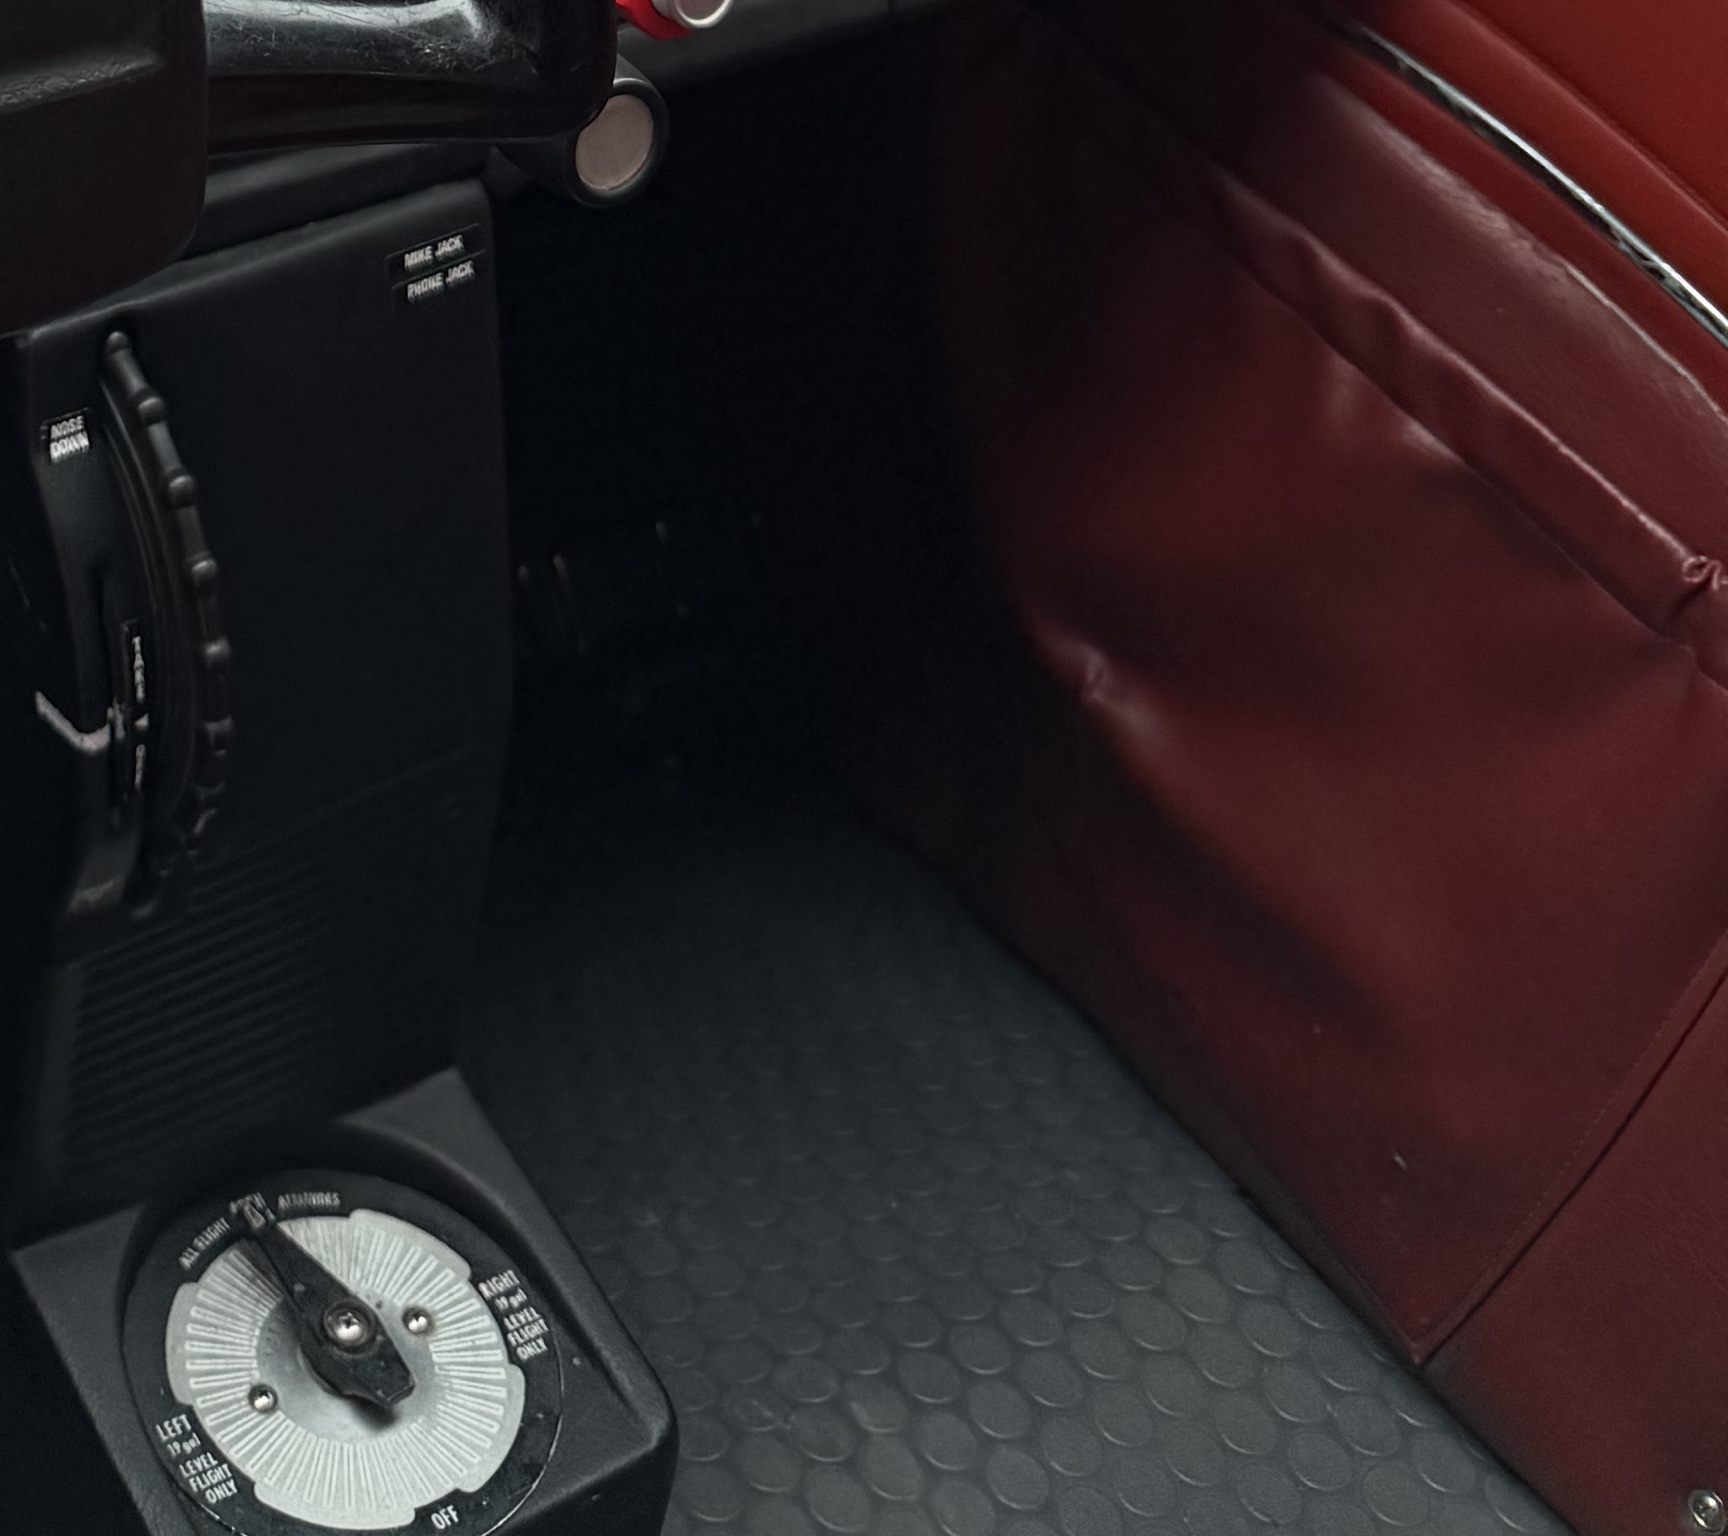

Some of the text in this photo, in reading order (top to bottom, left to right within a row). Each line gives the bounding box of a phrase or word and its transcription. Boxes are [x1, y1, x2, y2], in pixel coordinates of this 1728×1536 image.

[478, 1270, 520, 1300] RIGHT
[503, 1307, 541, 1330] LEVEL
[507, 1319, 549, 1346] FLIGHT
[516, 1337, 548, 1361] ONLY
[156, 1414, 192, 1442] LEFT
[179, 1452, 218, 1478] LEVEL
[189, 1464, 232, 1493] FLIGHT
[205, 1479, 238, 1504] ONLY
[431, 1504, 461, 1530] OFF
